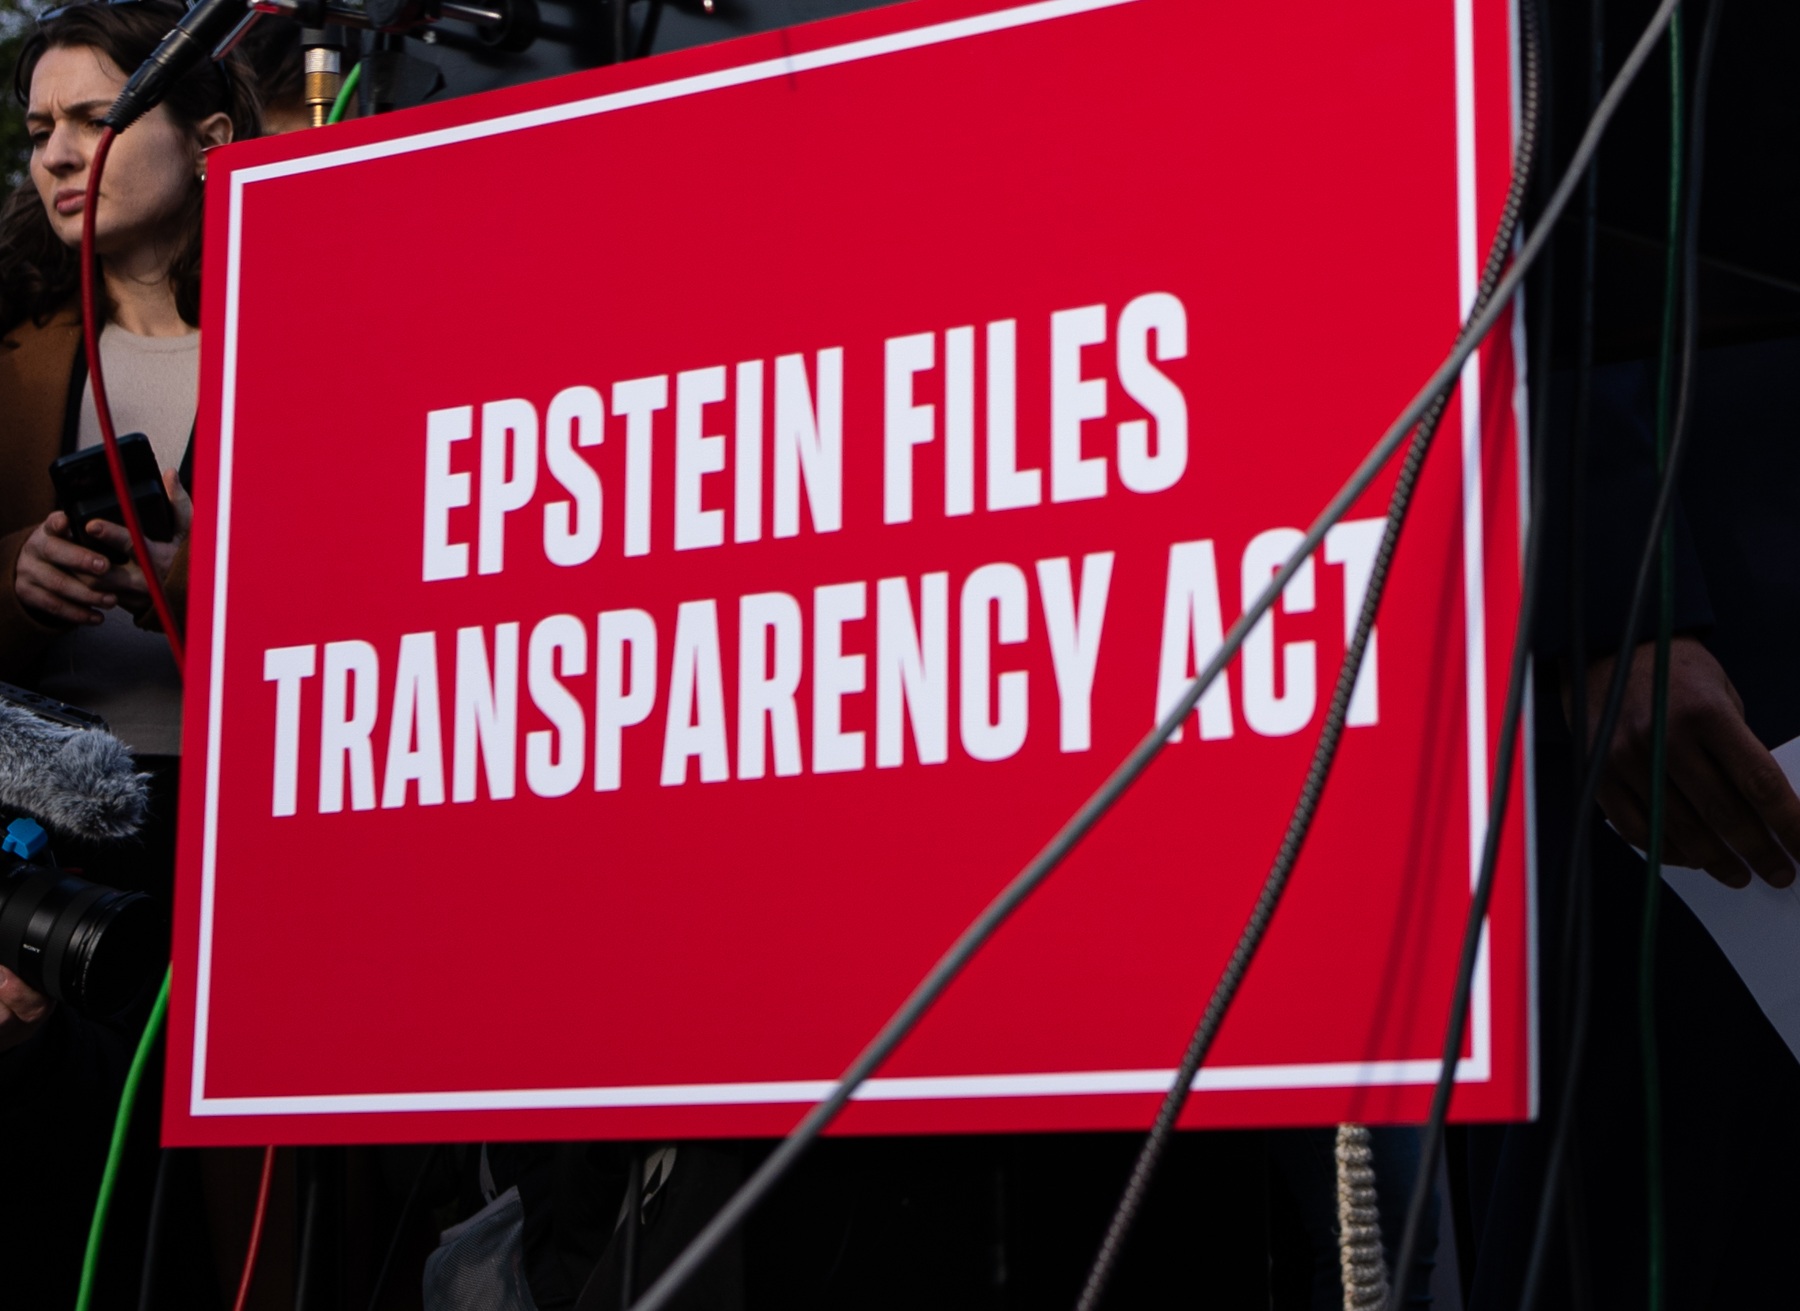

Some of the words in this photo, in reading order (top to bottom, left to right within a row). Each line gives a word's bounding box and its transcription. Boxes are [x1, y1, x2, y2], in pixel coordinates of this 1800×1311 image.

[421, 345, 844, 583] EPSTEIN
[883, 291, 1189, 526] FILES
[262, 550, 1116, 818] TRANSPARENCY
[1154, 516, 1391, 741] ACT
